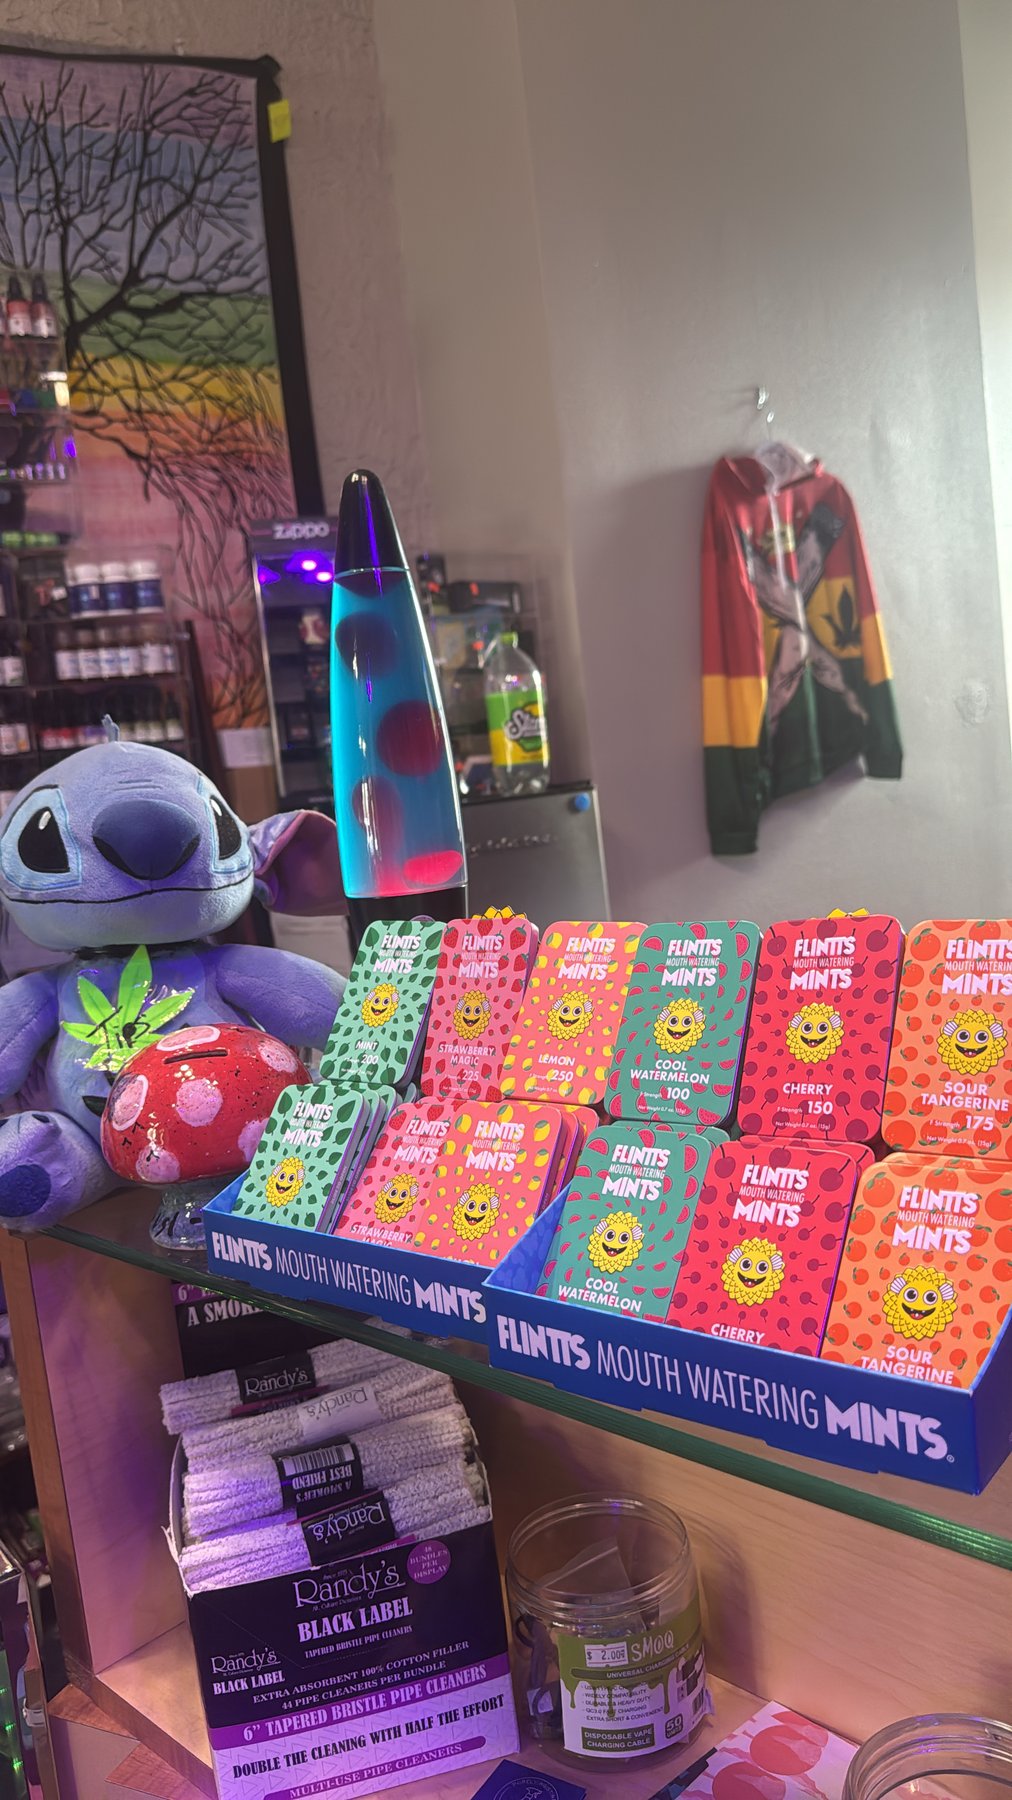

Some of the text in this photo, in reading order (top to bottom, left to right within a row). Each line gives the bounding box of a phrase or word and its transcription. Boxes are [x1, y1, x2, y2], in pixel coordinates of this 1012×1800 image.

[381, 935, 421, 950] FLINTTS
[462, 936, 503, 950] FLINTTS
[566, 937, 616, 953] FLINTTS
[668, 939, 722, 956] FLINTTS
[794, 936, 856, 958] FLINTTS
[373, 958, 414, 974] MINTS
[458, 962, 498, 978] MINTS
[558, 963, 608, 980] MINTS
[793, 957, 854, 968] MOUTH WATERING
[976, 961, 1012, 972] WATERIN
[662, 968, 717, 986] MINTS
[790, 968, 852, 990] MINTS
[355, 1040, 378, 1050] MINT
[439, 1044, 494, 1056] STRAWBERRY
[360, 1054, 378, 1064] 200
[450, 1056, 479, 1066] MAGIC
[538, 1054, 576, 1066] LEMON
[655, 1060, 687, 1071] COOL
[462, 1070, 479, 1080] 225
[551, 1070, 574, 1082] 250
[630, 1069, 710, 1084] WATERMELON
[667, 1087, 690, 1100] 100
[782, 1082, 833, 1095] CHERRY
[944, 1082, 988, 1096] SOUR
[292, 1101, 334, 1120] FLINTTS
[808, 1101, 834, 1114] 150
[921, 1093, 1009, 1112] TANGERINE
[406, 1120, 450, 1136] FLINTTS
[474, 1120, 526, 1142] FLINTTS
[966, 1116, 994, 1130] 175
[282, 1127, 324, 1148] MINTS
[393, 1145, 439, 1164] MINTS
[466, 1150, 516, 1172] MINTS
[612, 1144, 670, 1168] FLINTTS
[609, 1164, 666, 1180] MOUTH WATERING
[742, 1164, 810, 1190] FLINTTS
[602, 1175, 662, 1201] MINTS
[739, 1186, 805, 1204] MOUTH WATERING
[899, 1186, 979, 1214] FLINTTS
[732, 1198, 802, 1228] MINTS
[896, 1210, 976, 1228] MOUTH WATERING
[351, 1224, 412, 1243] STRAWBERRY
[892, 1222, 972, 1254] MINTS
[212, 1231, 486, 1324] FLINTTS MOUTH WATERING MINTS
[586, 1278, 618, 1294] COOL
[558, 1284, 642, 1312] WATERMELON
[188, 1306, 200, 1328] A
[711, 1324, 765, 1344] CHERRY
[886, 1345, 932, 1364] SOUR
[496, 1314, 591, 1370] FLINTTS
[598, 1340, 682, 1396] MOUTH
[685, 1360, 819, 1430] WATERING
[860, 1356, 954, 1384] TANGERINE
[245, 1367, 312, 1396] Randy's
[302, 1387, 368, 1420] Randy's
[292, 1464, 352, 1490] BEST FRIEND
[308, 1502, 386, 1544] Randy's
[292, 1560, 406, 1608] Randy's
[297, 1611, 356, 1642] BLACK
[359, 1596, 413, 1627] LABEL
[304, 1625, 412, 1658] TAPERED BRISTLE PIPE CLEANERS
[630, 1630, 674, 1662] SMOQ
[210, 1648, 280, 1674] Randy's
[586, 1651, 592, 1660] $
[253, 1640, 470, 1704] EXTRA ABSORBENT 100% COTTON FILLER
[606, 1668, 644, 1678] UNIVERSAL
[212, 1678, 248, 1695] BLACK
[251, 1670, 286, 1688] LABEL
[282, 1660, 446, 1710] 44 PIPE CLEANERS PER BUNDLE
[265, 1709, 328, 1736] TAPERED
[332, 1692, 388, 1721] BRISTLE
[390, 1684, 423, 1705] PIPE
[426, 1664, 487, 1694] CLEANERS
[666, 1716, 682, 1732] 50
[232, 1694, 505, 1778] DOUBLE THE CLEANING WITH HALF THE EFFORT
[584, 1728, 652, 1740] DISPOSABLE VAPE
[587, 1738, 650, 1748] CHARGING CABLE
[289, 1744, 462, 1798] MULTI-USE PIPE CLEANERS
